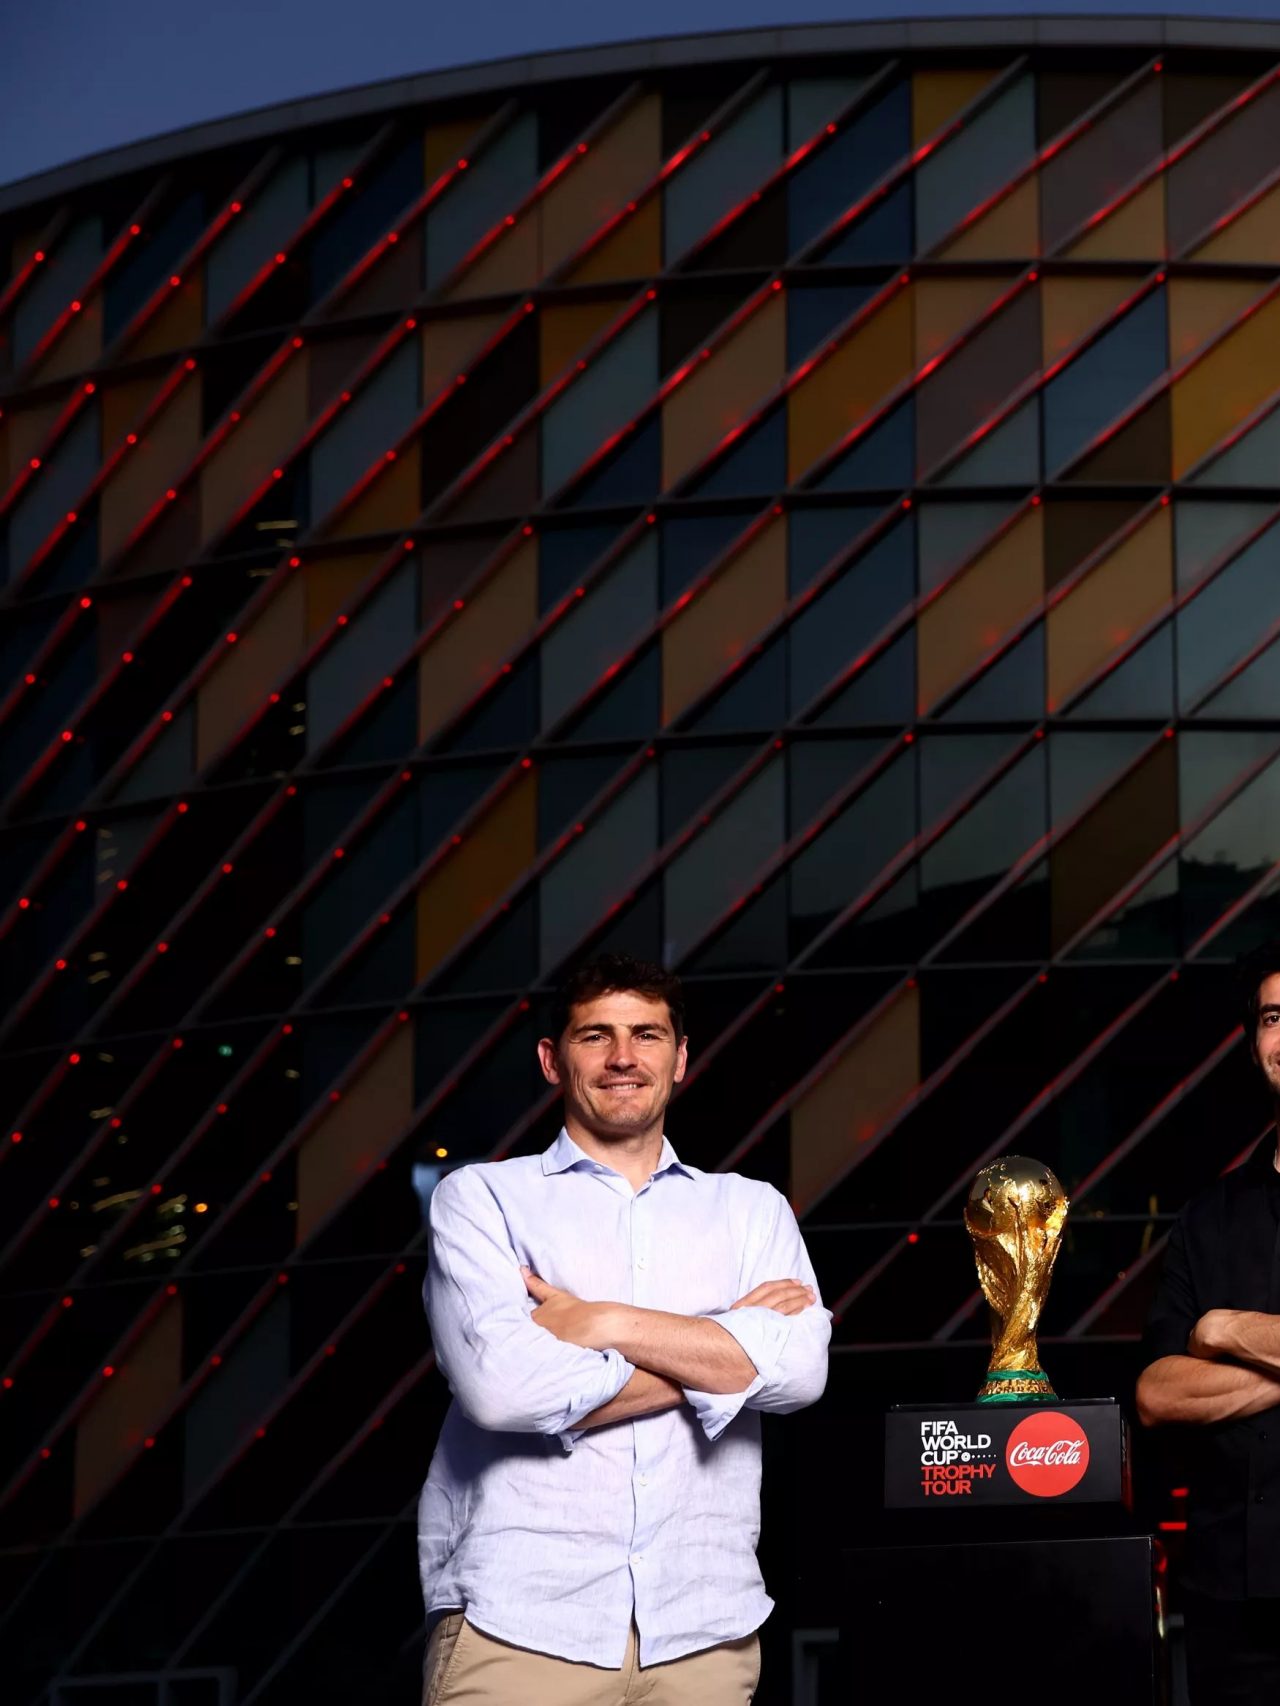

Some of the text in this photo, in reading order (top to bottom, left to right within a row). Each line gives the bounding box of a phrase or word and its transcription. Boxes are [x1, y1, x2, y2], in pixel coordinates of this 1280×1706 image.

[921, 1421, 958, 1436] FIFA
[922, 1434, 991, 1450] WORLD
[1010, 1440, 1085, 1467] Coca-Cola
[921, 1464, 996, 1481] TROPHY
[921, 1480, 971, 1496] TOUR
